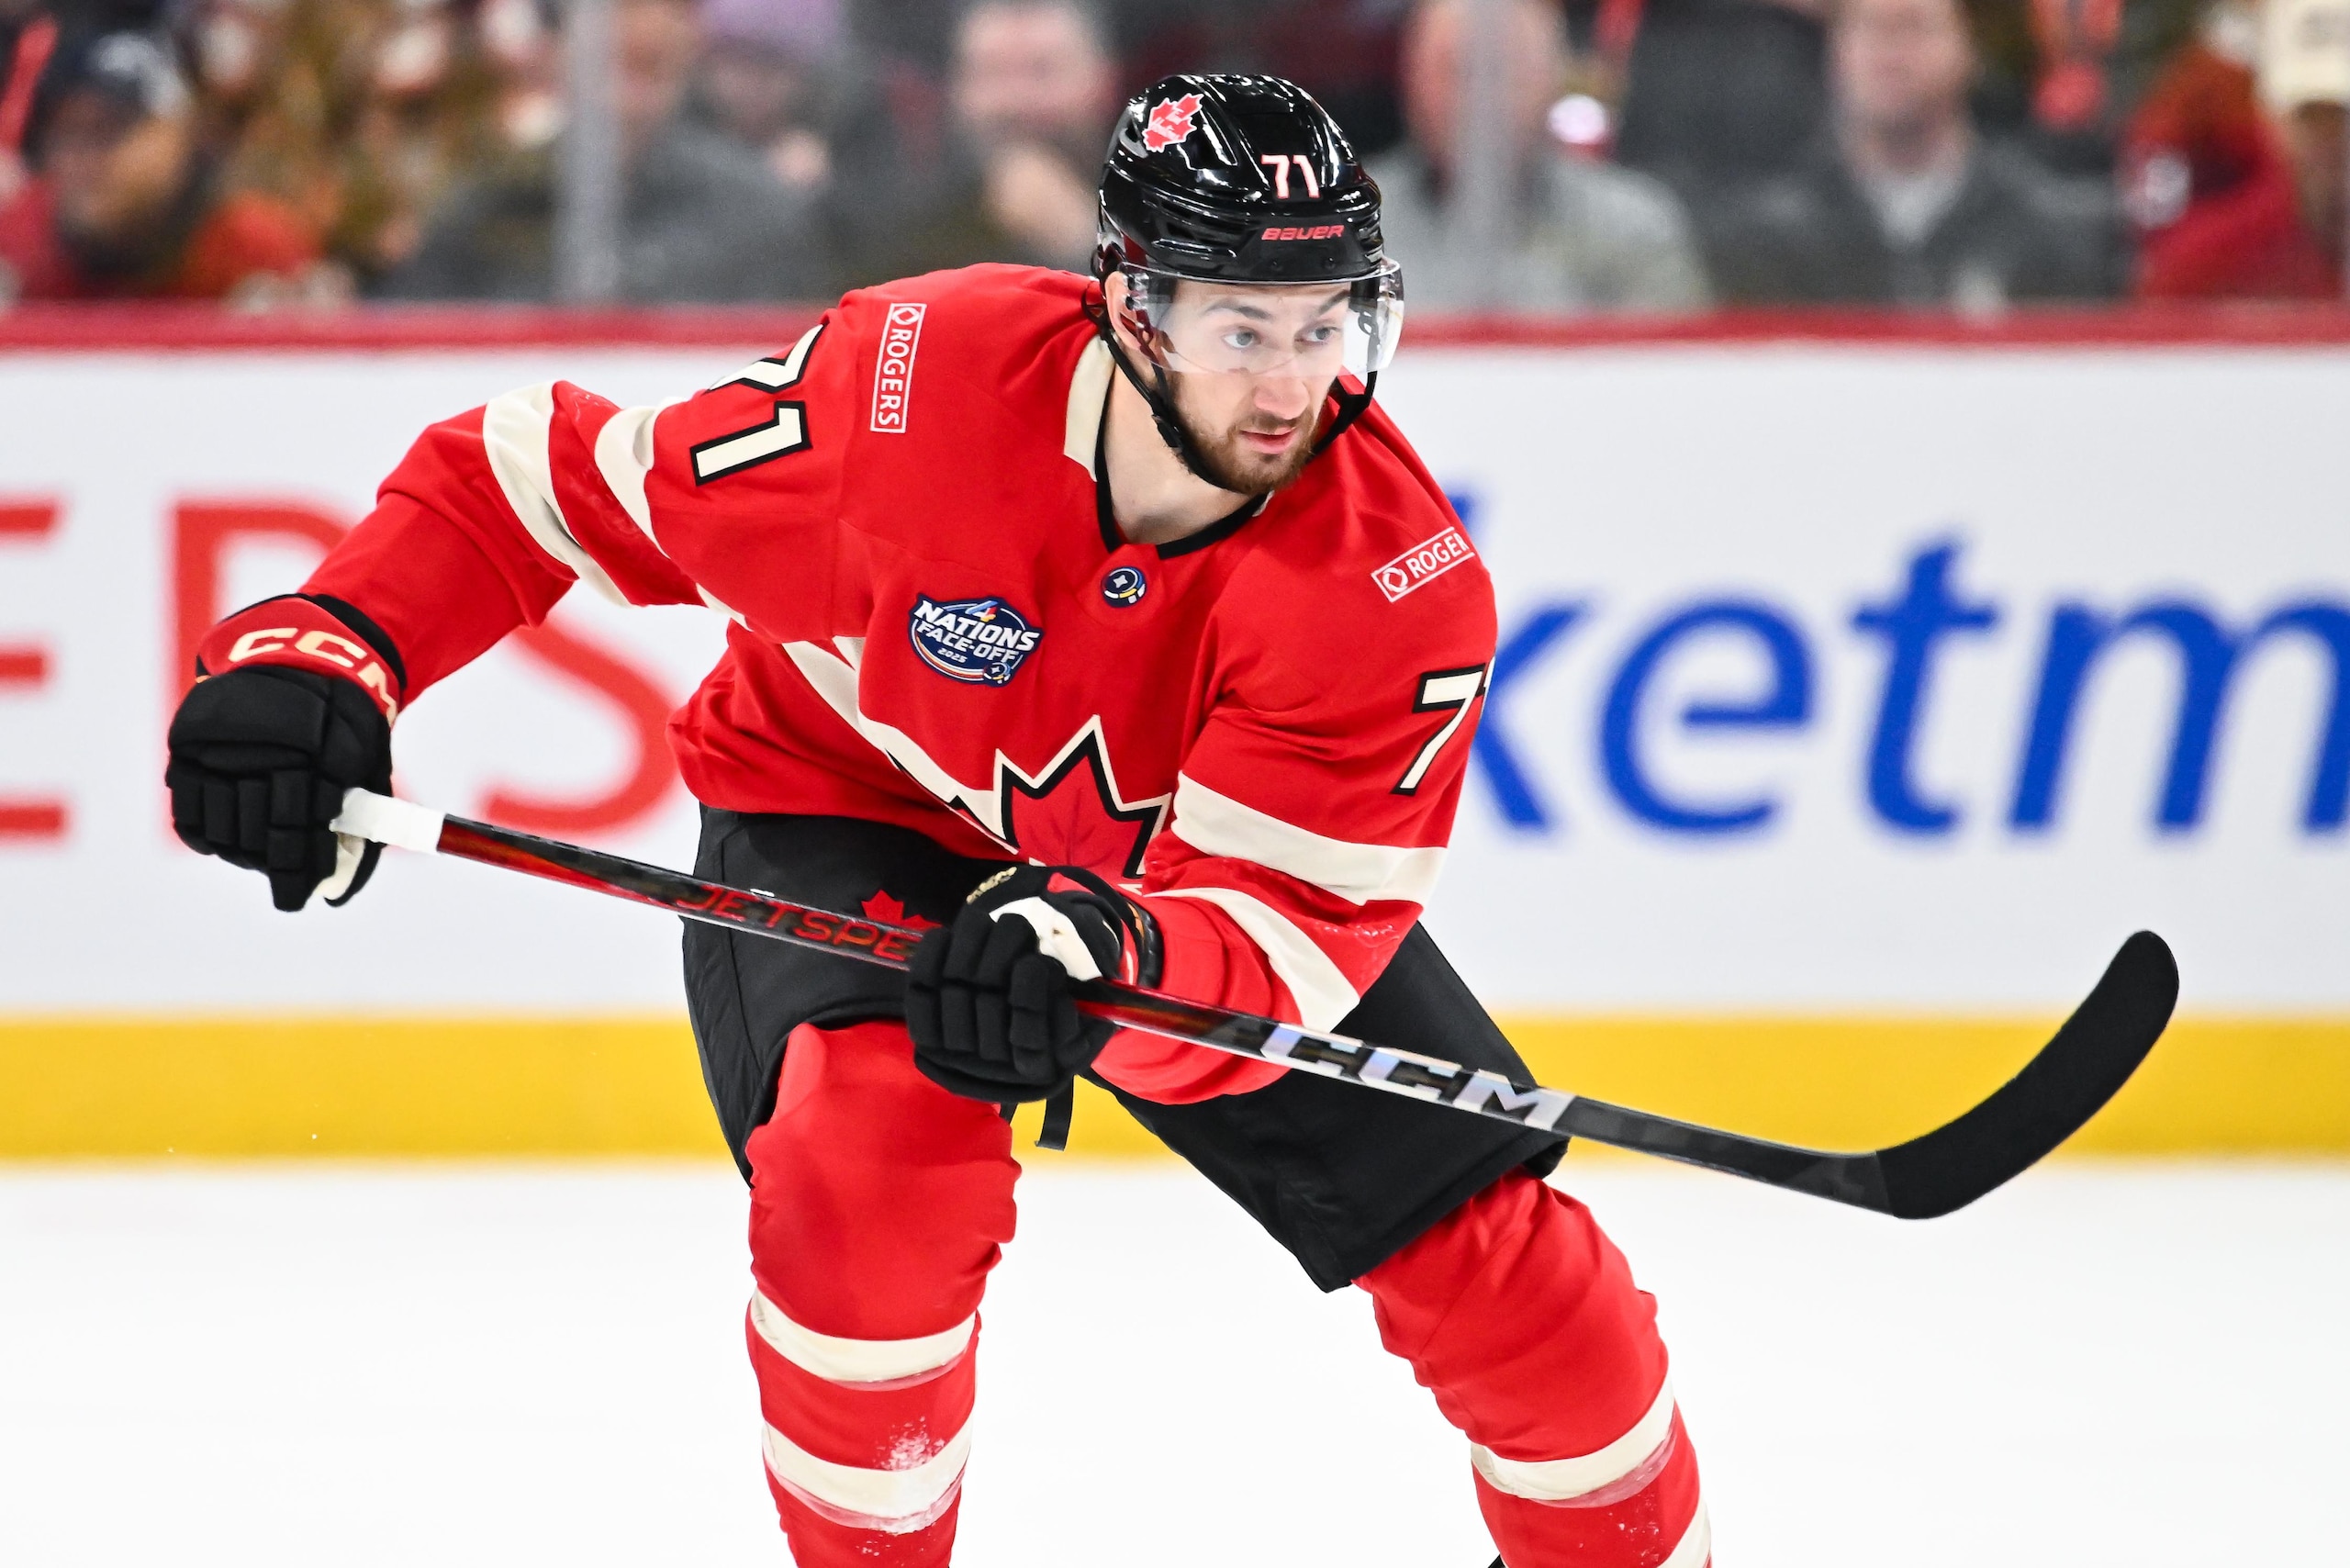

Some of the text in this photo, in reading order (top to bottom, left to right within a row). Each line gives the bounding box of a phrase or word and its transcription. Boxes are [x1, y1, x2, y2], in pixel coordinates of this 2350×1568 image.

[1260, 154, 1320, 199] 71
[1261, 225, 1345, 241] BAUER
[878, 328, 917, 427] ROGERS
[913, 599, 1040, 652] NATIONS
[916, 621, 1020, 663] FACE-OFF
[936, 647, 968, 664] 2025
[1390, 655, 1495, 796] 7
[1260, 1022, 1575, 1131] CCM
